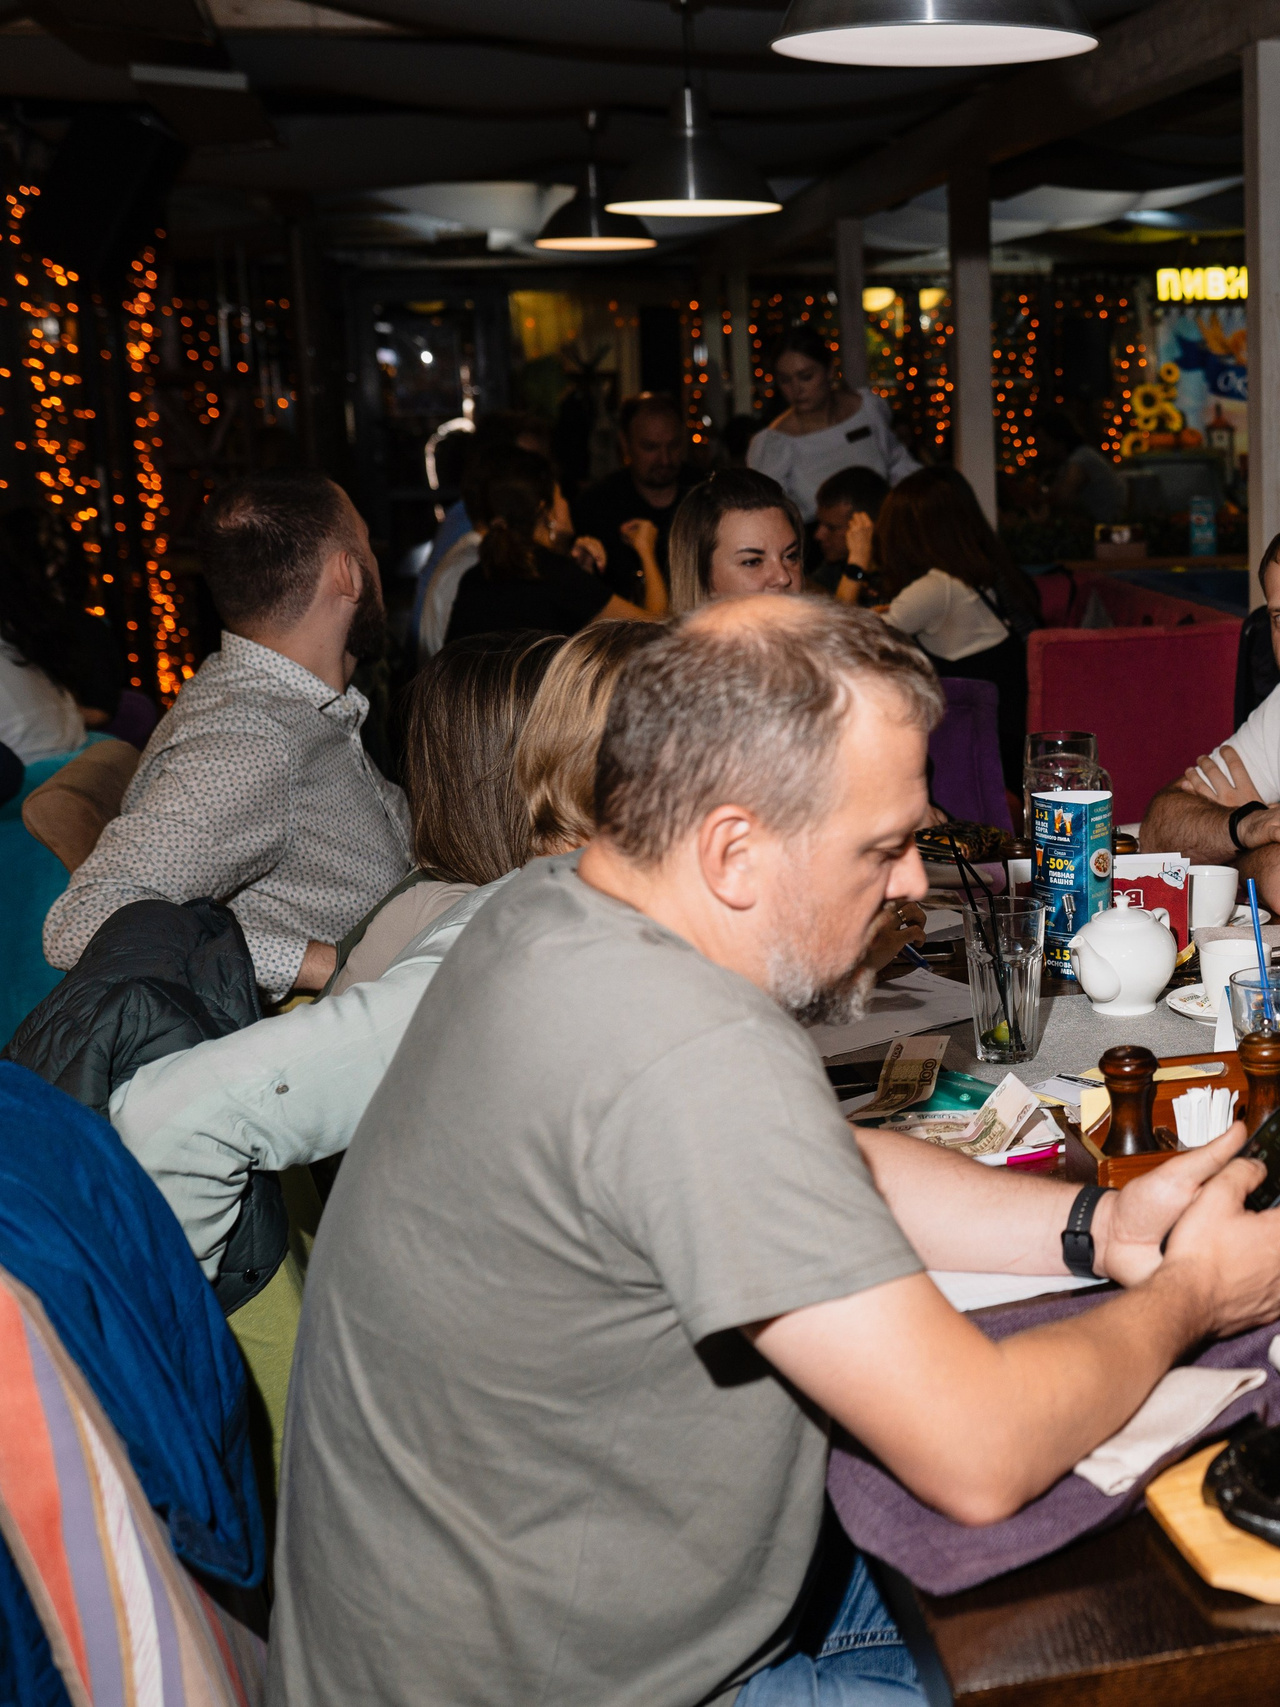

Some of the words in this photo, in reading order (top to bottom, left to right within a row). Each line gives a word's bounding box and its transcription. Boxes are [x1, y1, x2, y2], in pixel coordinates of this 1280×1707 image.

[1156, 265, 1249, 302] ПИВН
[1035, 808, 1049, 821] 1+1
[1046, 857, 1075, 872] -50%
[1048, 870, 1075, 880] ПИВНАЯ
[1049, 877, 1074, 886] БАШНЯ
[1050, 948, 1071, 961] -15
[1047, 959, 1073, 969] ОСНОВН
[1060, 968, 1075, 976] МЕН
[918, 1058, 938, 1087] 100
